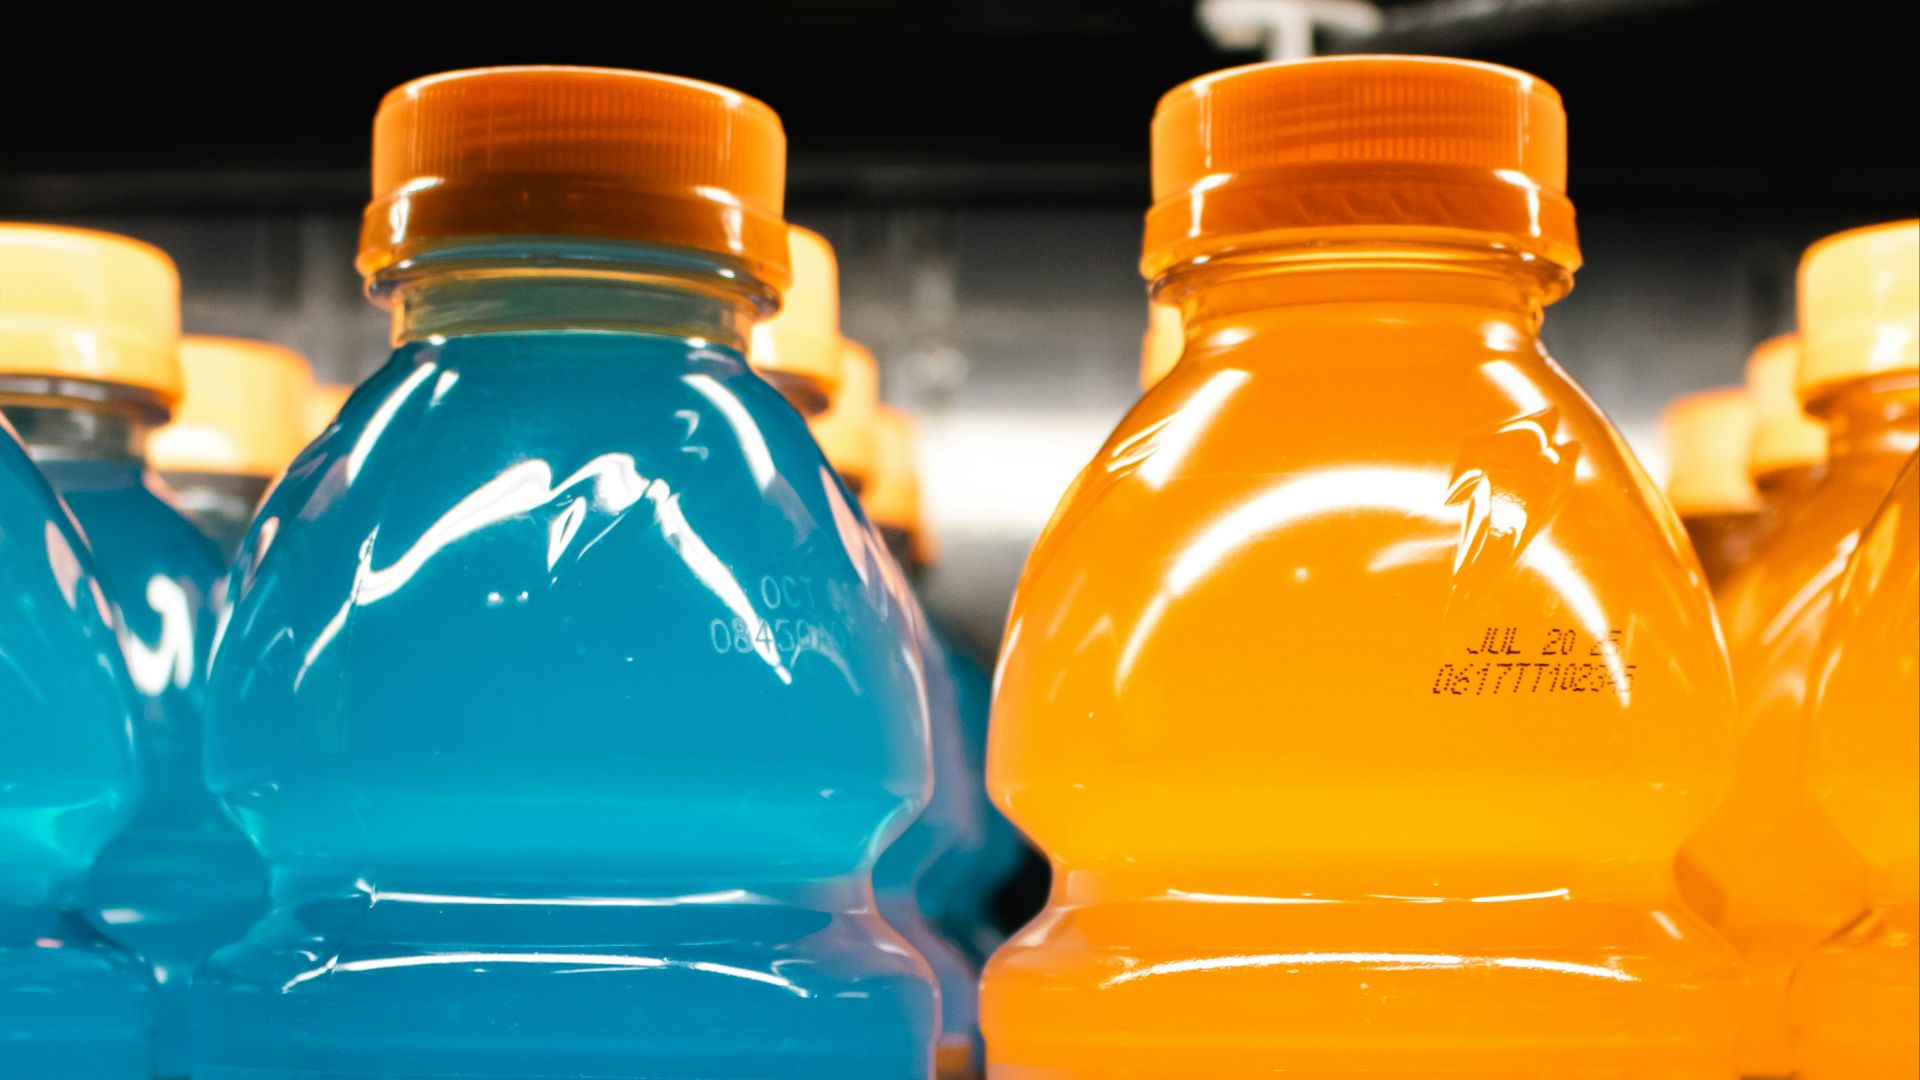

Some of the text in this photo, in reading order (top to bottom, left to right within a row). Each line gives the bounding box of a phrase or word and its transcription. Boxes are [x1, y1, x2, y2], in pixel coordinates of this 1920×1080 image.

[761, 575, 815, 609] OCT
[1466, 627, 1521, 655] JUL
[1542, 628, 1576, 656] 20
